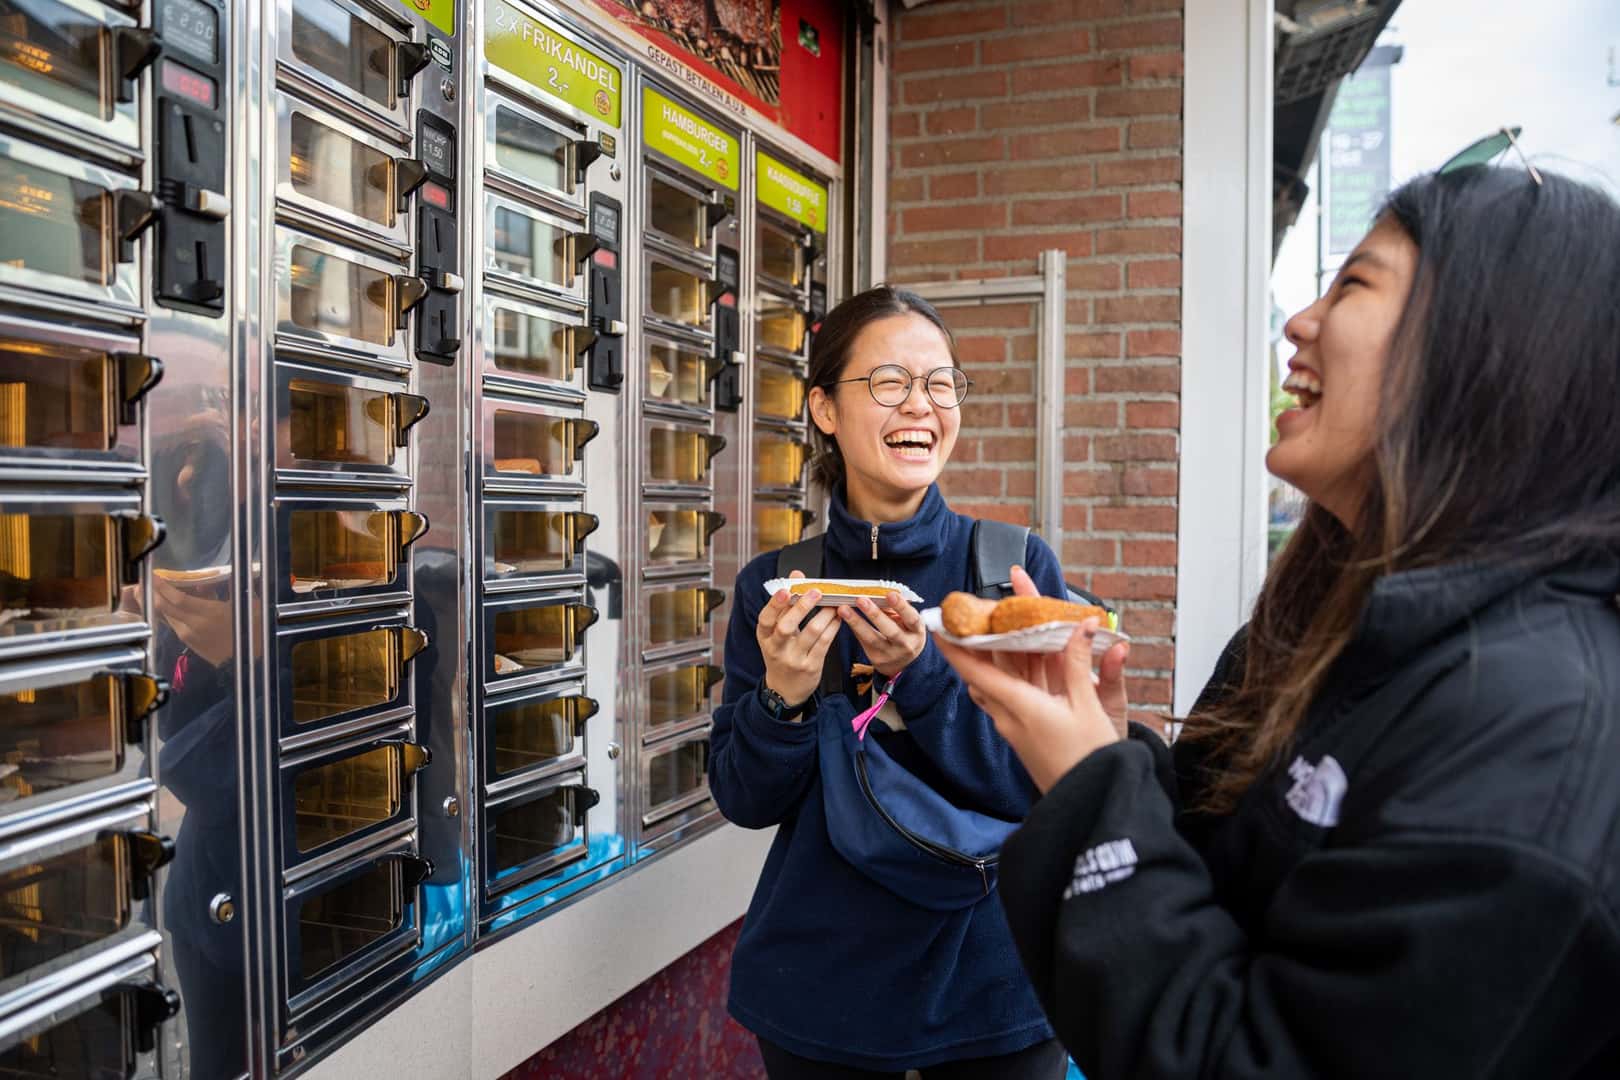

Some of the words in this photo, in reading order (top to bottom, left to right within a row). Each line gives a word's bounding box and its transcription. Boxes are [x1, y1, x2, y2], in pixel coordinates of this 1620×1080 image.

[495, 5, 505, 27] 2
[522, 21, 617, 94] FRIKANDEL
[647, 45, 685, 77] GEPAST
[662, 103, 729, 154] HAMBURGER
